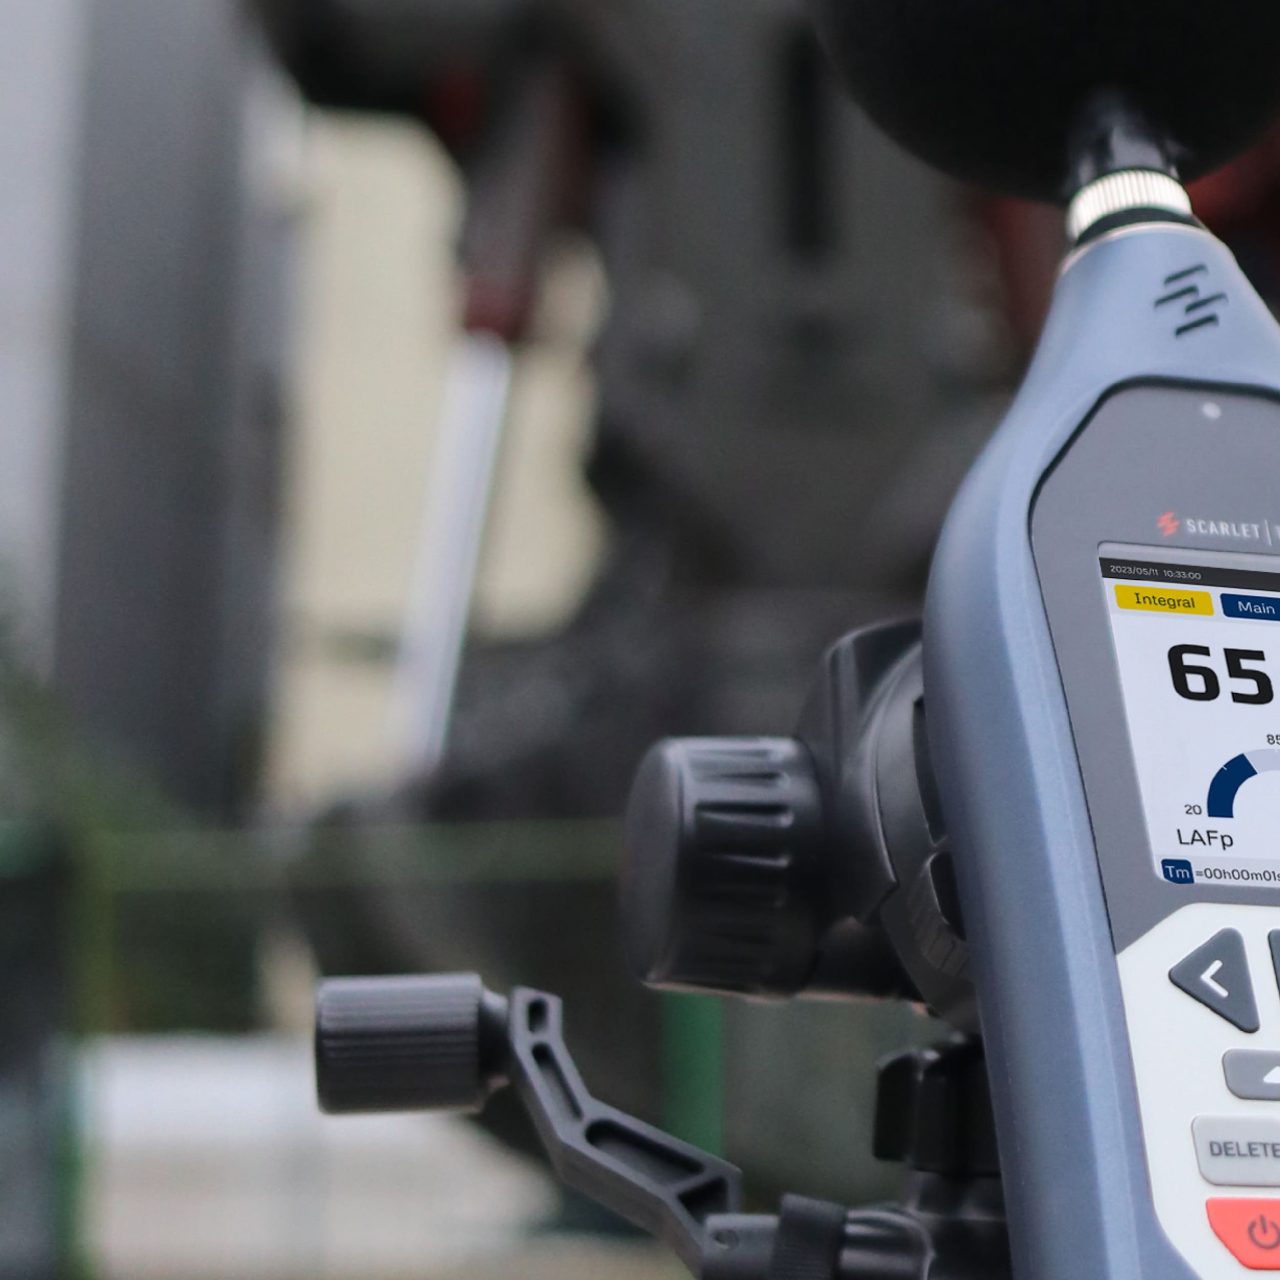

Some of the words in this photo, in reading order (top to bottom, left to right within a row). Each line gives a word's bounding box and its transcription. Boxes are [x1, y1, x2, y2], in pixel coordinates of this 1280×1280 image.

[1186, 518, 1260, 540] SCARLET
[1110, 564, 1159, 577] 2023/05/11
[1135, 592, 1196, 610] Integral
[1237, 601, 1276, 615] Main
[1184, 804, 1202, 815] 20
[1176, 828, 1234, 850] LAFp
[1164, 865, 1190, 879] Tm
